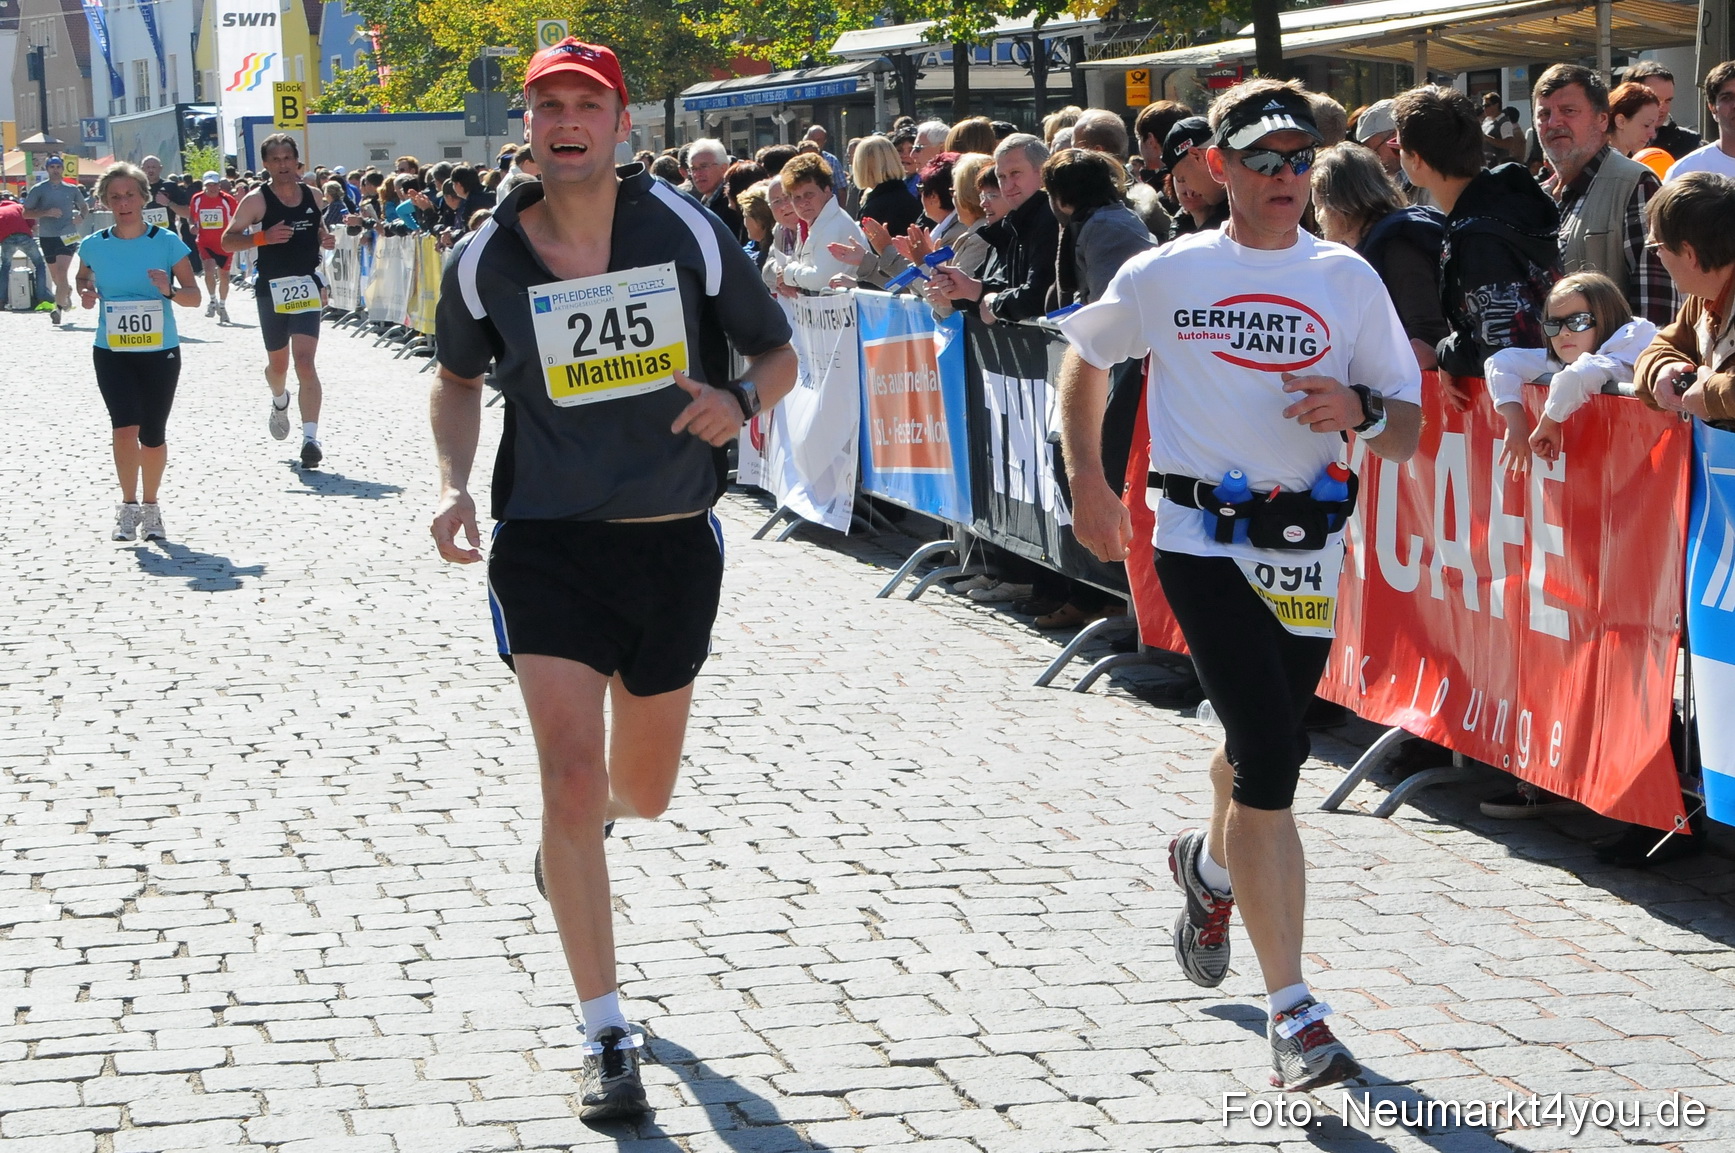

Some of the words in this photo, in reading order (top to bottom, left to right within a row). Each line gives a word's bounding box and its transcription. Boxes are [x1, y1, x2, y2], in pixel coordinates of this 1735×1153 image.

[222, 12, 277, 28] swn
[276, 83, 302, 92] Block
[282, 95, 299, 119] B
[66, 161, 75, 173] C
[147, 213, 163, 223] 512
[204, 214, 218, 222] 279
[282, 284, 309, 302] 223
[551, 285, 614, 304] PFLEIDERER
[284, 300, 311, 310] Günter
[118, 313, 152, 332] 460
[1174, 309, 1302, 333] GERHART
[1305, 322, 1315, 334] &
[567, 302, 655, 358] 245
[1177, 331, 1231, 341] Autohaus
[119, 334, 152, 345] Nicola
[565, 352, 672, 388] Matthias
